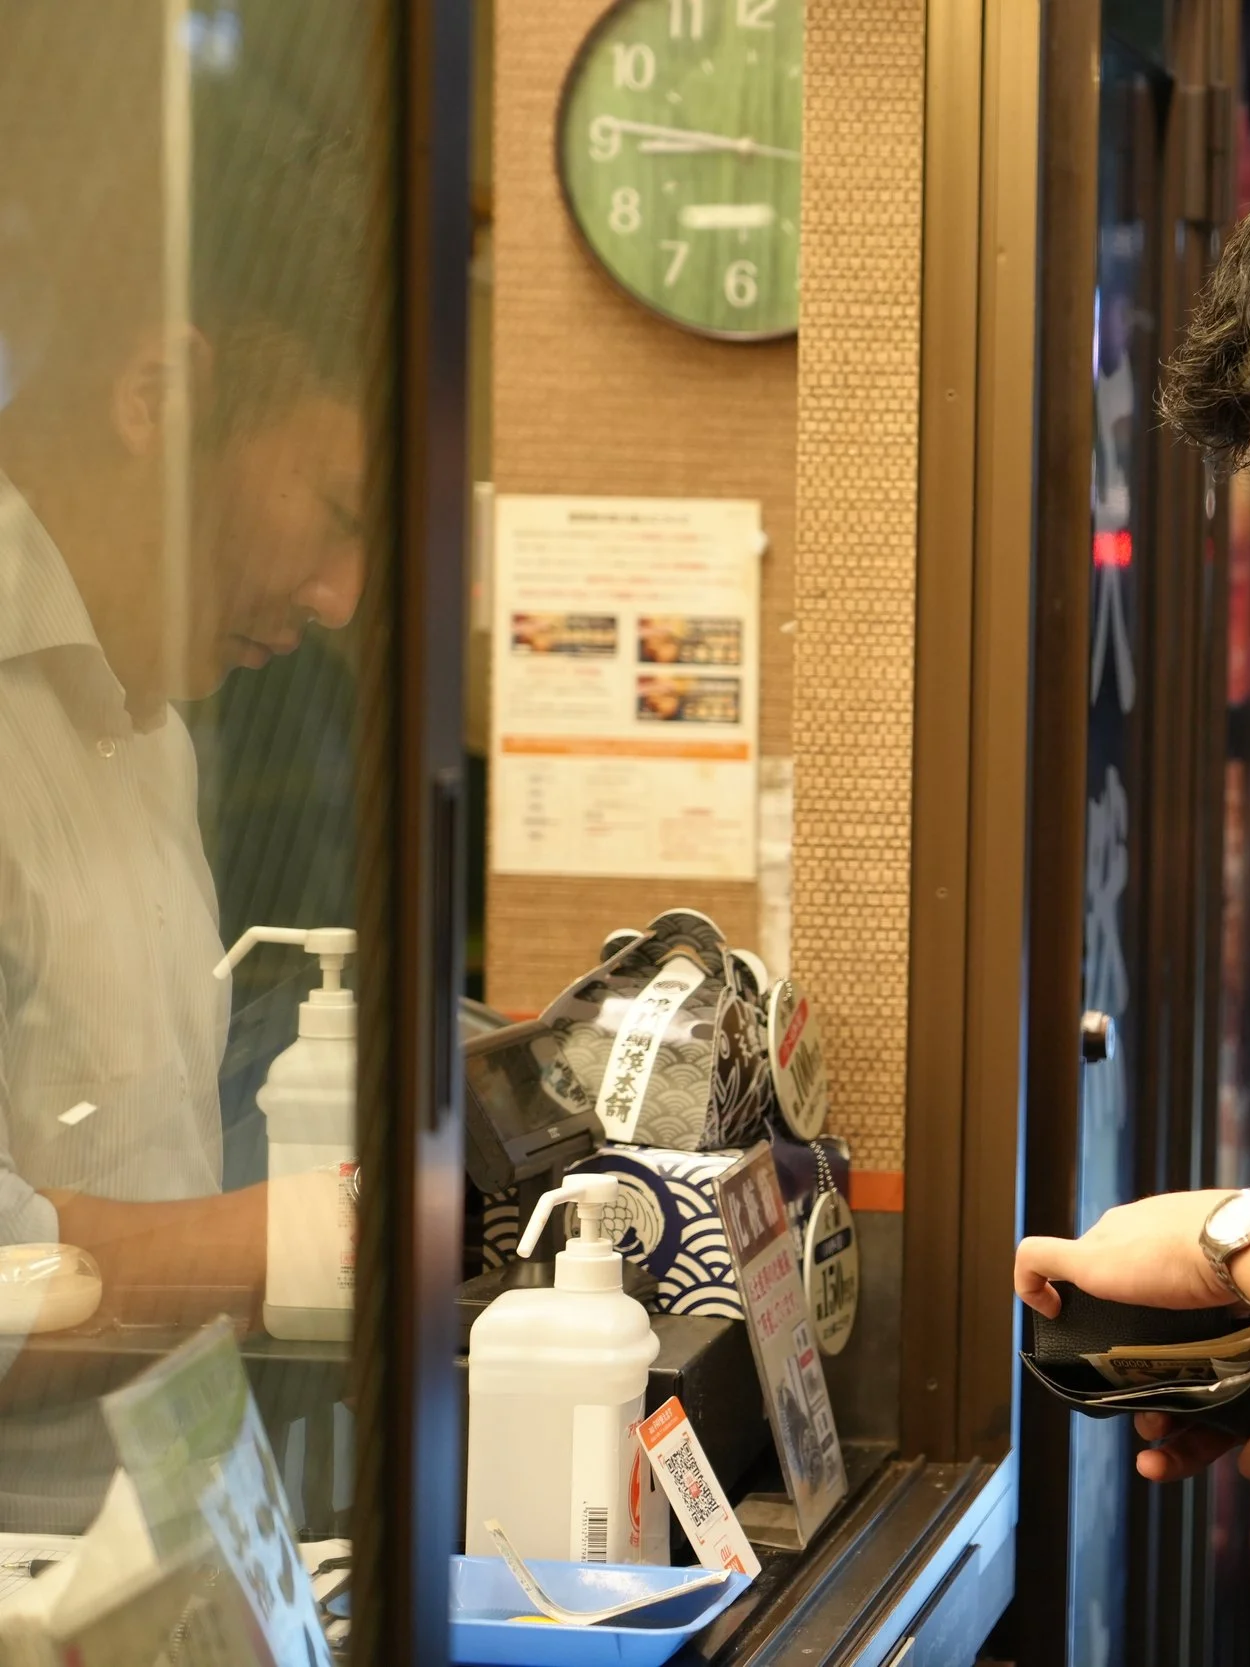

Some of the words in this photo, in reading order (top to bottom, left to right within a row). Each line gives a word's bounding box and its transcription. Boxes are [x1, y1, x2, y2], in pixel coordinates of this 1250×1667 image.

[612, 43, 656, 91] 10
[588, 114, 623, 163] 9
[607, 186, 642, 236] 8
[658, 239, 690, 287] 7
[723, 259, 758, 308] 6
